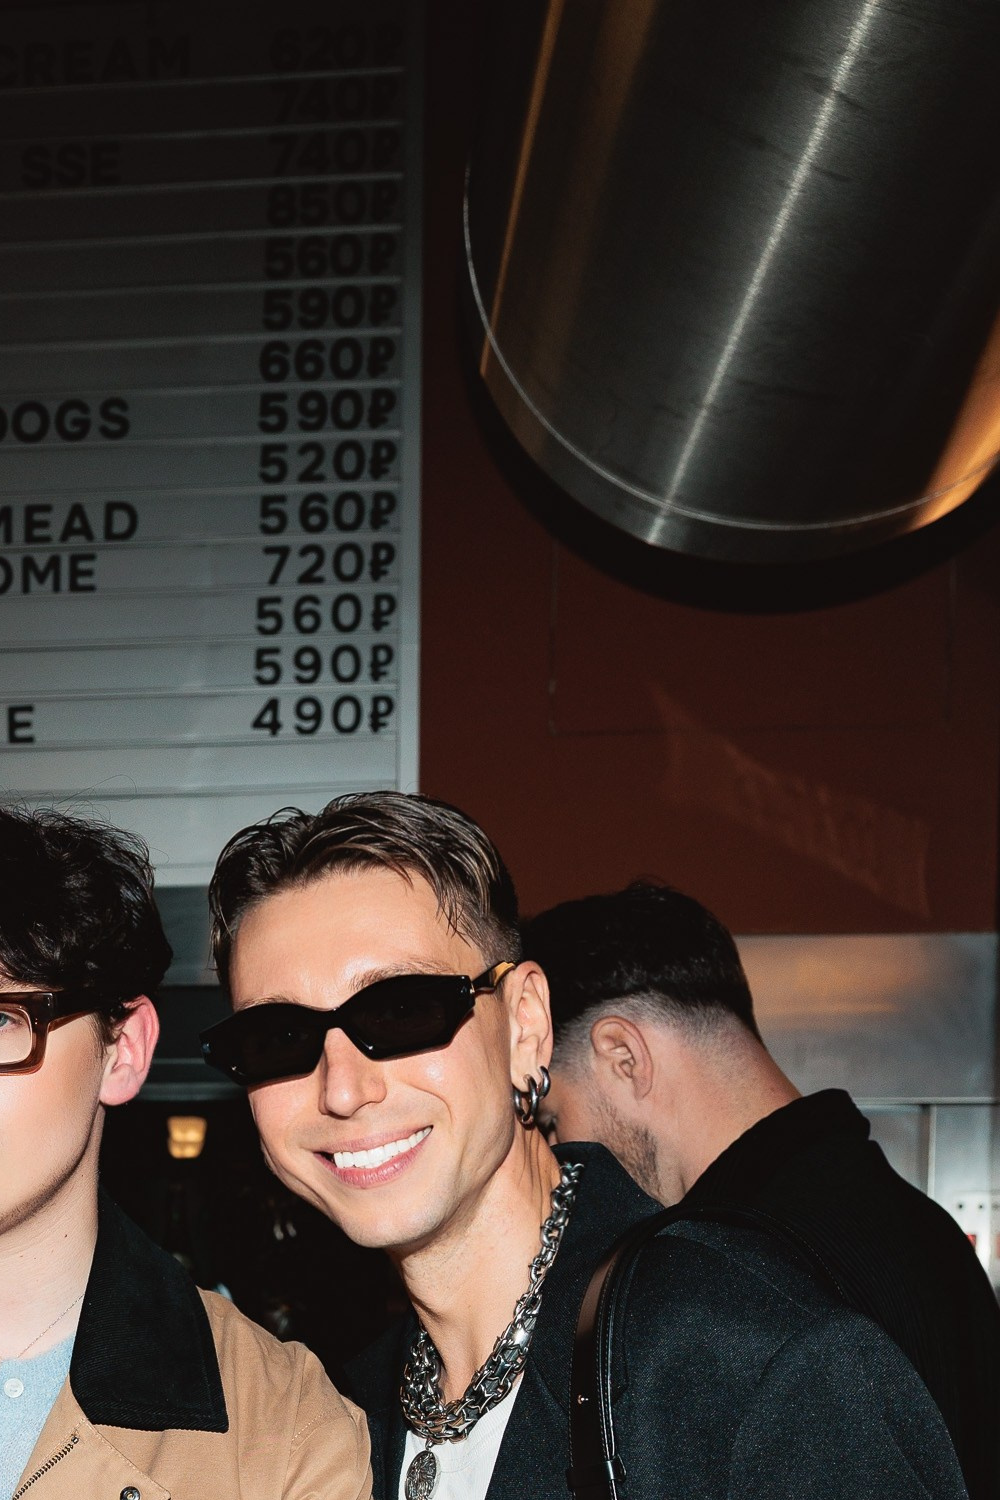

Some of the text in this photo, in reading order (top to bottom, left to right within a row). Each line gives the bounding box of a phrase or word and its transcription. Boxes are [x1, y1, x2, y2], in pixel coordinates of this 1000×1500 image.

[267, 182, 398, 228] 850₽
[265, 235, 398, 280] 560₽
[263, 286, 398, 332] 590₽
[260, 339, 396, 382] 660₽
[259, 389, 397, 433] 590₽
[259, 440, 397, 483] 520₽
[259, 491, 396, 535] 560₽
[263, 542, 396, 585] 720₽
[257, 593, 396, 635] 560₽
[254, 643, 393, 685] 590₽
[252, 695, 394, 736] 490₽
